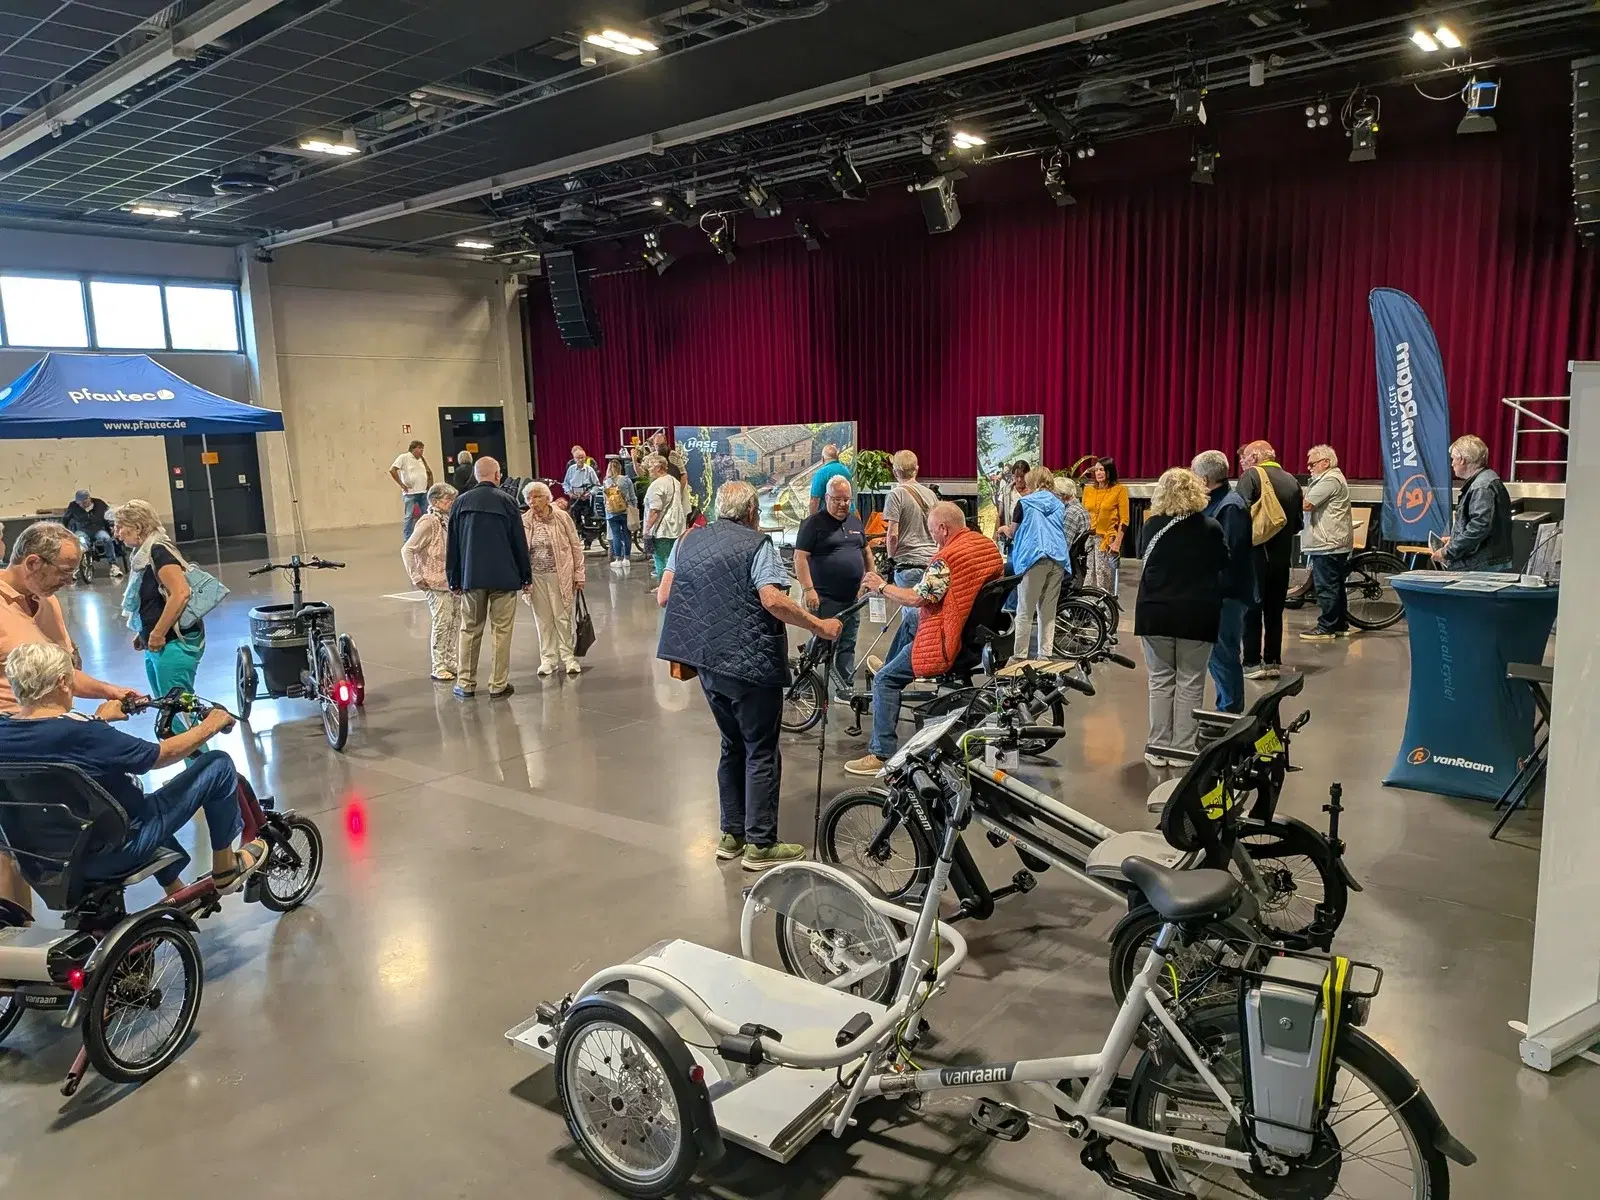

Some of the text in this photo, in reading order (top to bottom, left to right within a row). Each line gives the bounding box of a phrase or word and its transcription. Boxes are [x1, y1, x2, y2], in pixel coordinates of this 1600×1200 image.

[68, 388, 158, 404] pfautec
[103, 420, 188, 432] www.pfautec.de
[687, 440, 719, 448] HASE
[1441, 645, 1453, 662] all
[1433, 755, 1495, 774] vanRaam
[905, 787, 932, 831] vanraam
[993, 826, 1010, 839] FUN
[1015, 840, 1028, 850] GO
[25, 995, 57, 1004] vanraam
[945, 1067, 1007, 1085] vanraam
[1211, 1152, 1232, 1161] PLUS
